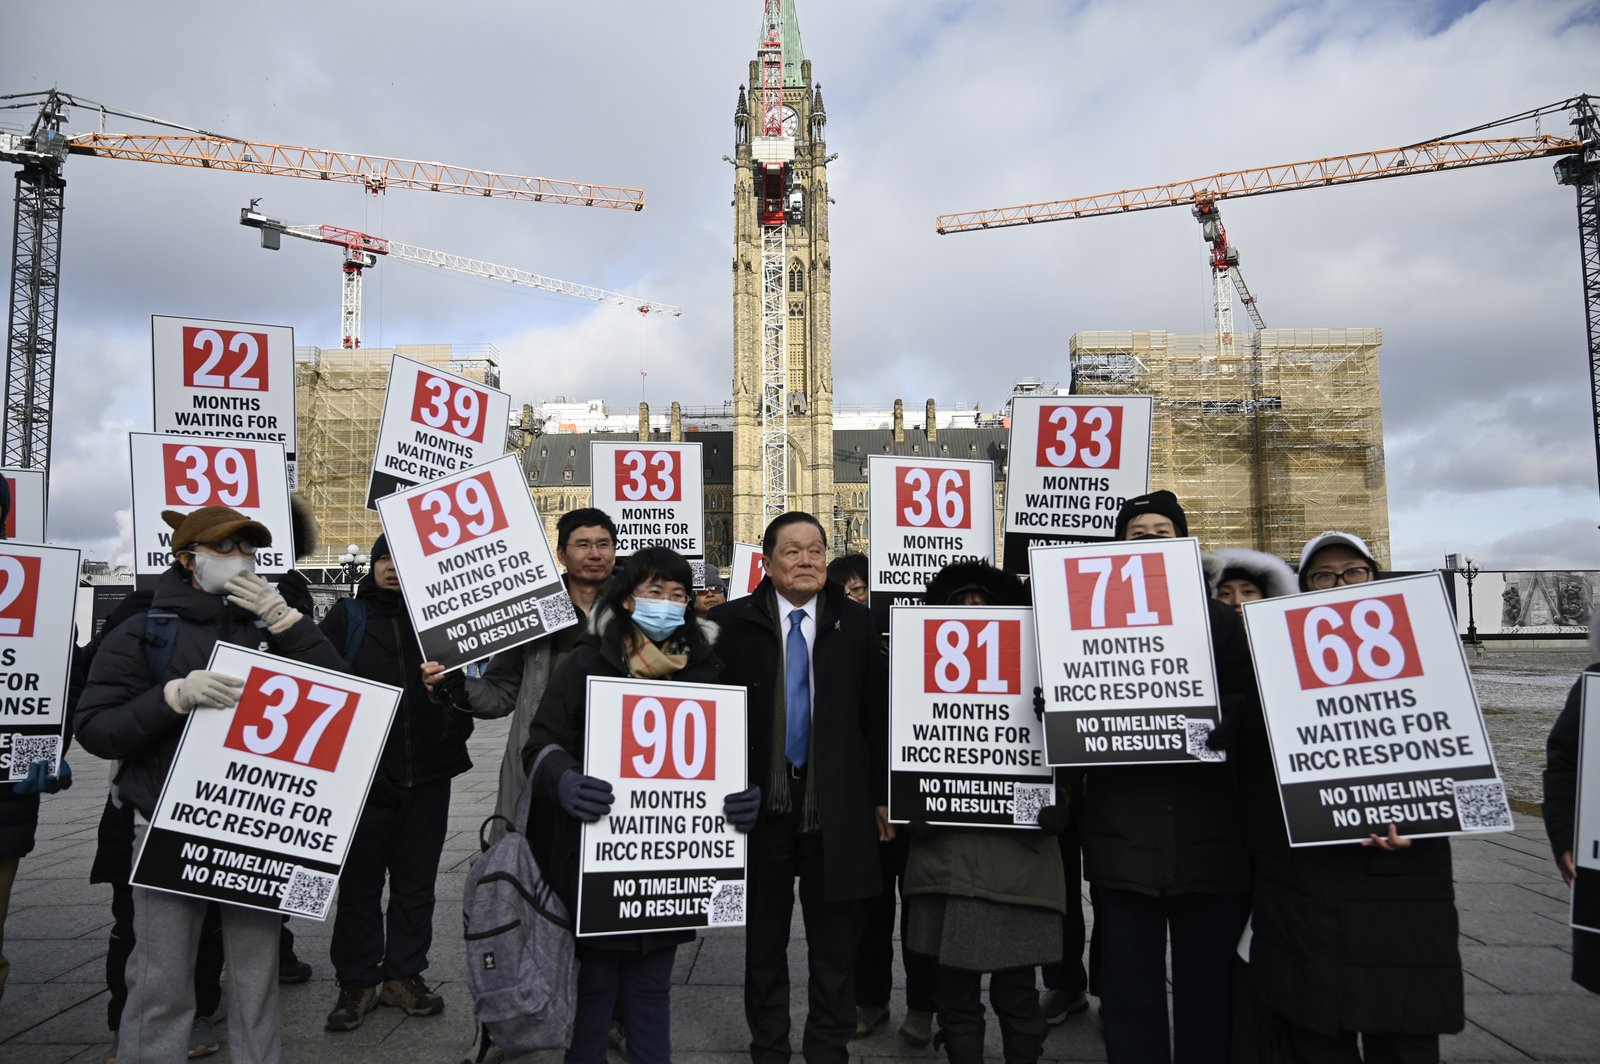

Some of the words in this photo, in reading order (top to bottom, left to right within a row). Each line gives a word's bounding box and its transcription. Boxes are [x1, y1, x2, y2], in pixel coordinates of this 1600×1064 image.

[192, 330, 260, 390] 22
[193, 395, 261, 411] MONTHS
[420, 377, 480, 438] 39
[175, 412, 243, 428] WAITING
[248, 415, 278, 429] FOR
[414, 431, 473, 459] MONTHS
[1045, 406, 1113, 468] 33
[384, 454, 418, 475] IRCC
[397, 441, 456, 470] WAITING
[175, 445, 249, 507] 39
[622, 451, 675, 501] 33
[1042, 476, 1110, 492] MONTHS
[903, 468, 964, 528] 36
[1025, 494, 1090, 510] WAITING
[1095, 496, 1126, 511] FOR
[420, 478, 495, 549] 39
[622, 508, 675, 520] MONTHS
[1015, 512, 1049, 527] IRCC
[1051, 513, 1114, 530] RESPON
[664, 523, 689, 535] FOR
[903, 535, 964, 550] MONTHS
[437, 539, 508, 575] MONTHS
[616, 538, 629, 550] CC
[147, 551, 172, 567] IRC
[888, 553, 948, 568] WAITING
[425, 564, 496, 599] WAITING
[498, 550, 532, 573] FOR
[879, 570, 911, 585] IRCC
[421, 596, 460, 621] IRCC
[462, 564, 548, 608] RESPONSE
[1078, 555, 1159, 628] 71
[446, 623, 468, 641] NO
[469, 596, 539, 632] TIMELINES
[457, 636, 479, 654] NO
[480, 613, 540, 646] RESULTS
[1082, 636, 1165, 656] MONTHS
[1303, 598, 1406, 686] 68
[934, 620, 1008, 693] 81
[1064, 659, 1145, 679] WAITING
[1150, 657, 1189, 675] FOR
[1054, 684, 1097, 702] IRCC
[1099, 680, 1204, 700] RESPONSE
[1316, 688, 1417, 718] MONTHS
[242, 675, 349, 765] 37
[932, 702, 1010, 721] MONTHS
[1076, 717, 1099, 733] NO
[1101, 714, 1186, 732] TIMELINES
[631, 697, 707, 779] 90
[912, 724, 989, 743] WAITING
[995, 726, 1031, 744] FOR
[1296, 716, 1397, 746] WAITING
[1401, 711, 1452, 735] FOR
[901, 746, 941, 763] IRCC
[944, 747, 1042, 767] RESPONSE
[1085, 736, 1108, 752] NO
[1112, 734, 1183, 751] RESULTS
[1288, 749, 1341, 773] IRCC
[1344, 735, 1474, 768] RESPONSE
[225, 761, 318, 798] MONTHS
[919, 778, 940, 794] NO
[943, 779, 1018, 796] TIMELINE
[1319, 786, 1348, 806] NO
[1350, 777, 1455, 804] TIMELINES
[195, 780, 285, 817] WAITING
[290, 804, 333, 827] FOR
[630, 790, 707, 809] MONTHS
[926, 797, 947, 812] NO
[951, 798, 1015, 815] RESULTS
[609, 816, 687, 835] WAITING
[691, 815, 726, 834] FOR
[1332, 808, 1361, 827] NO
[1365, 800, 1454, 825] RESULTS
[170, 802, 222, 829] IRCC
[222, 813, 338, 853] RESPONSE
[181, 842, 209, 861] NO
[212, 848, 302, 879] TIMELINE
[595, 841, 638, 862] IRCC
[641, 840, 735, 860] RESPONSE
[181, 864, 209, 885] NO
[211, 869, 289, 899] RESULTS
[613, 879, 636, 897] NO
[638, 876, 717, 896] TIMELINES
[619, 900, 642, 918] NO
[645, 897, 710, 918] RESULTS
